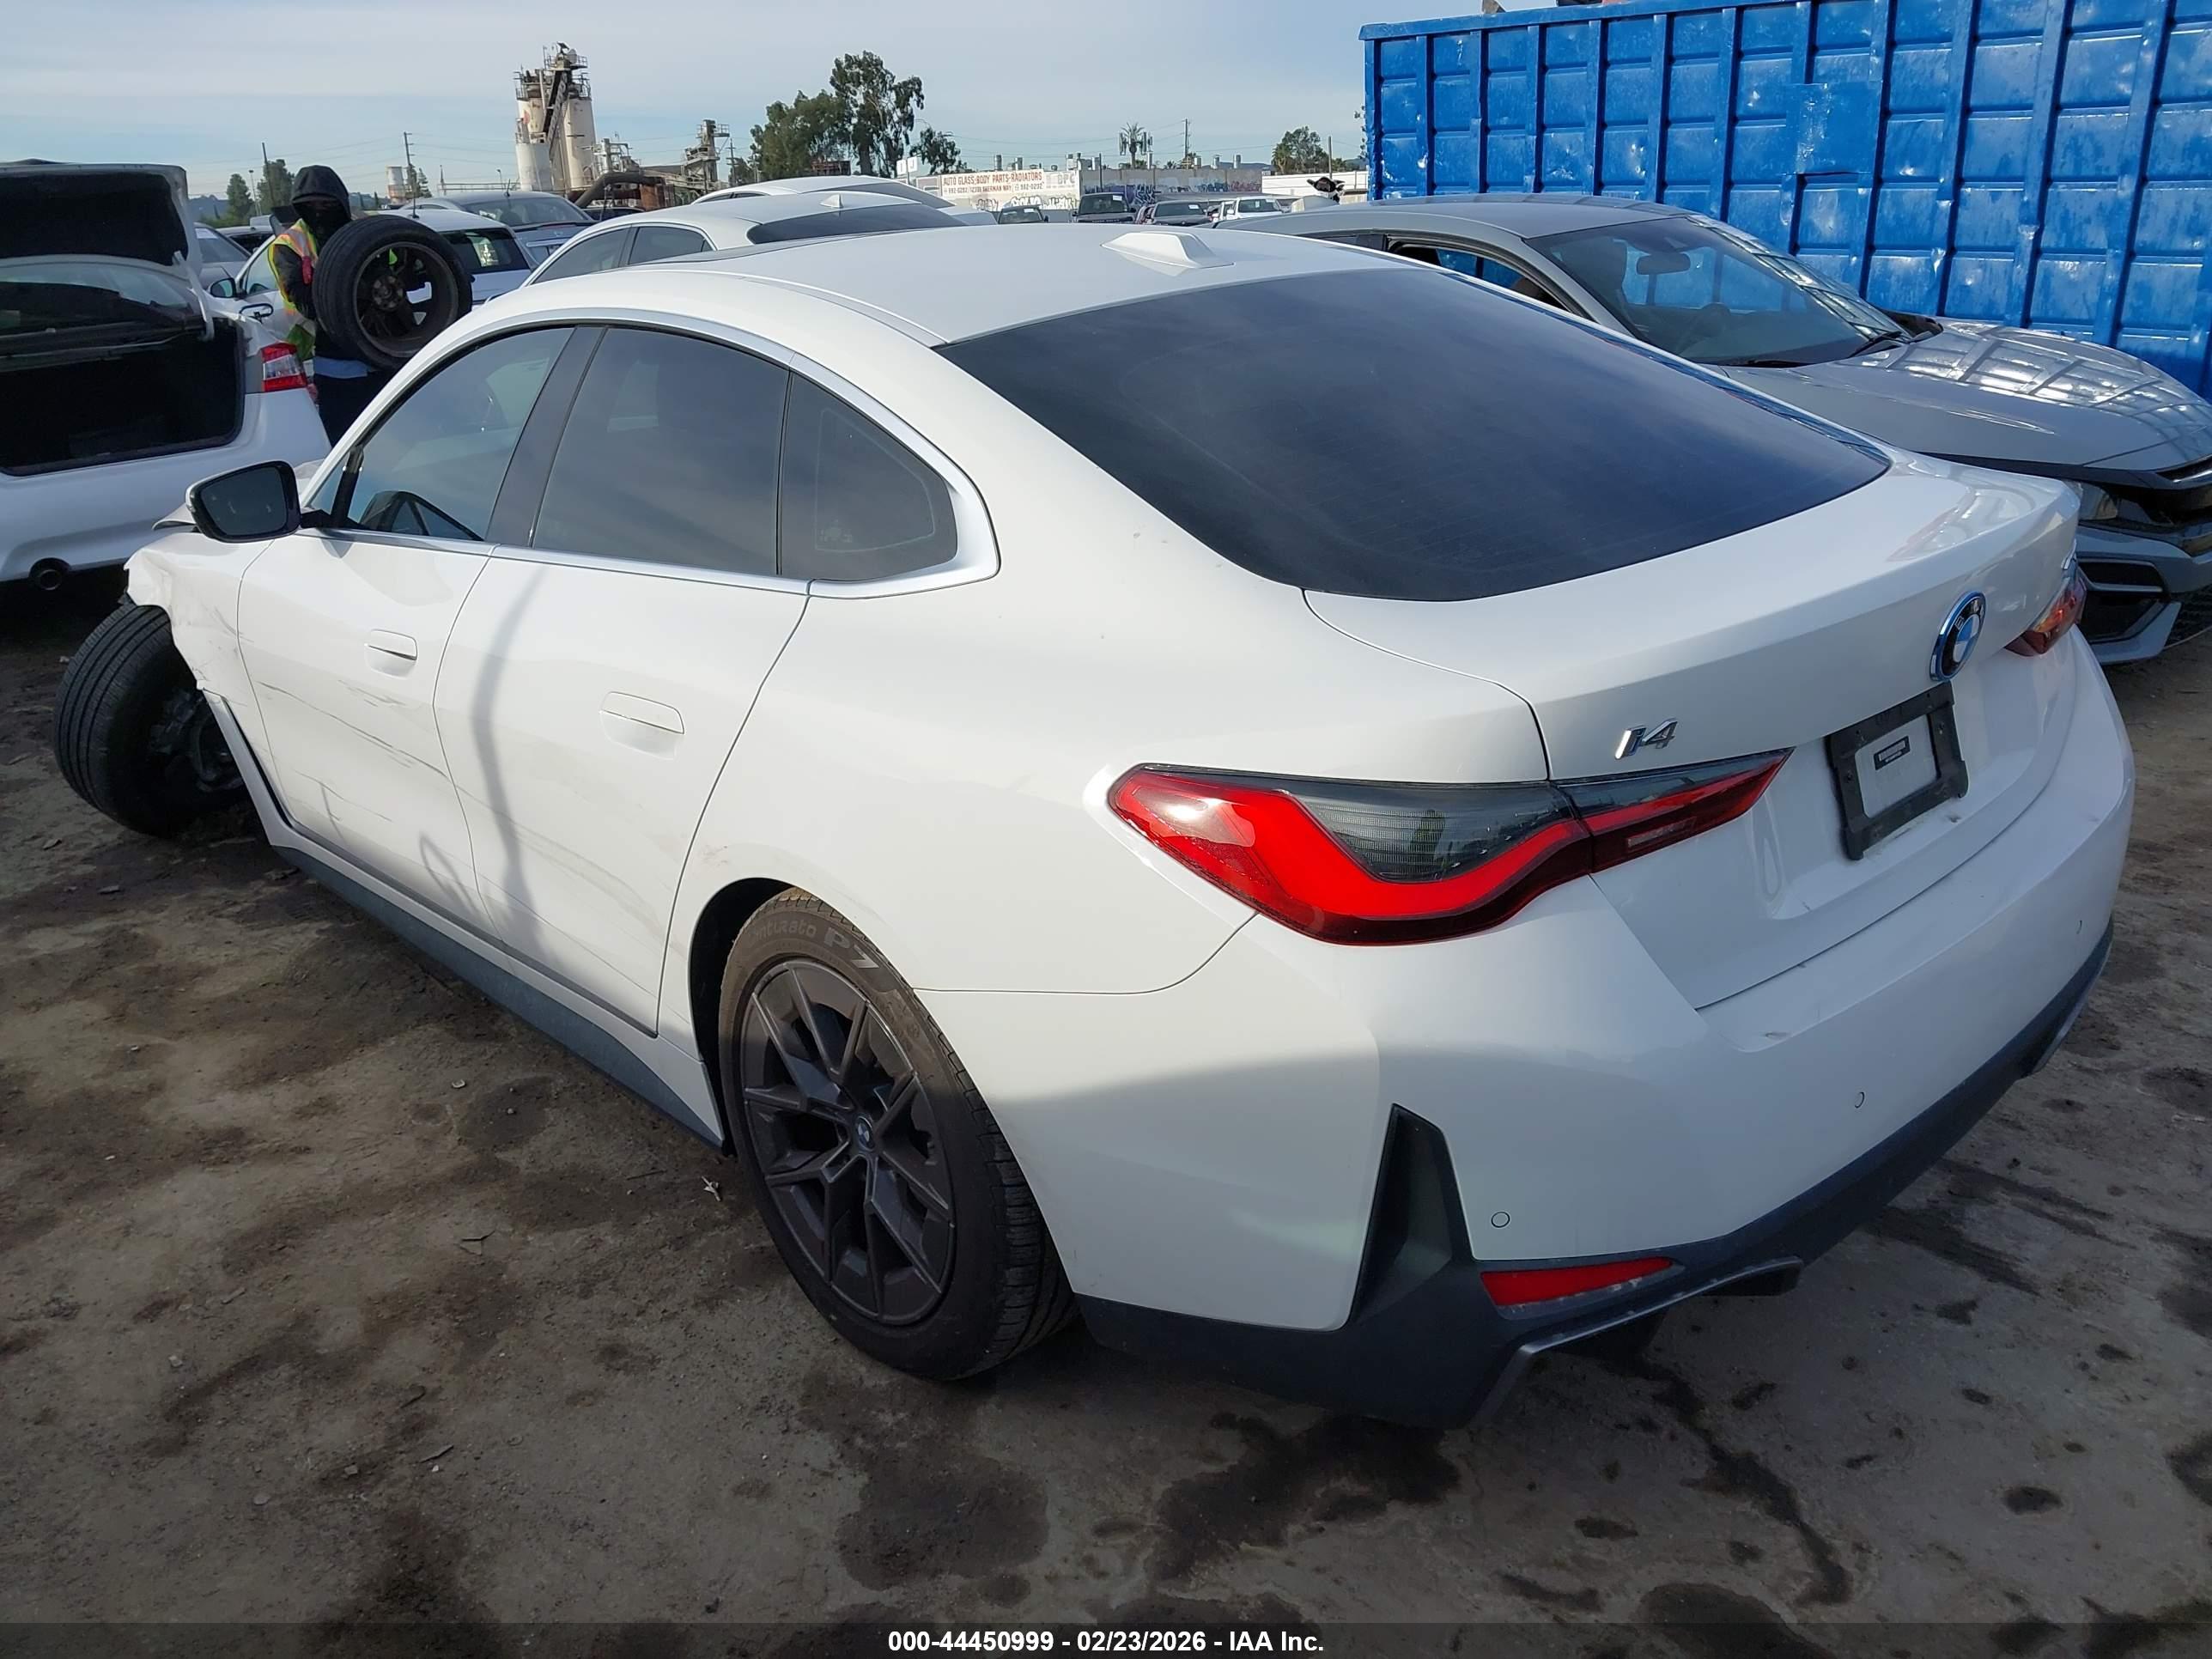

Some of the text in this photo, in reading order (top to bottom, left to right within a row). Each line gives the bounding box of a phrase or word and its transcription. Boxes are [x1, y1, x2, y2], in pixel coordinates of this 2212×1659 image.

[943, 177, 957, 185] AUTO
[1614, 719, 1678, 761] i4
[824, 927, 879, 969] P7
